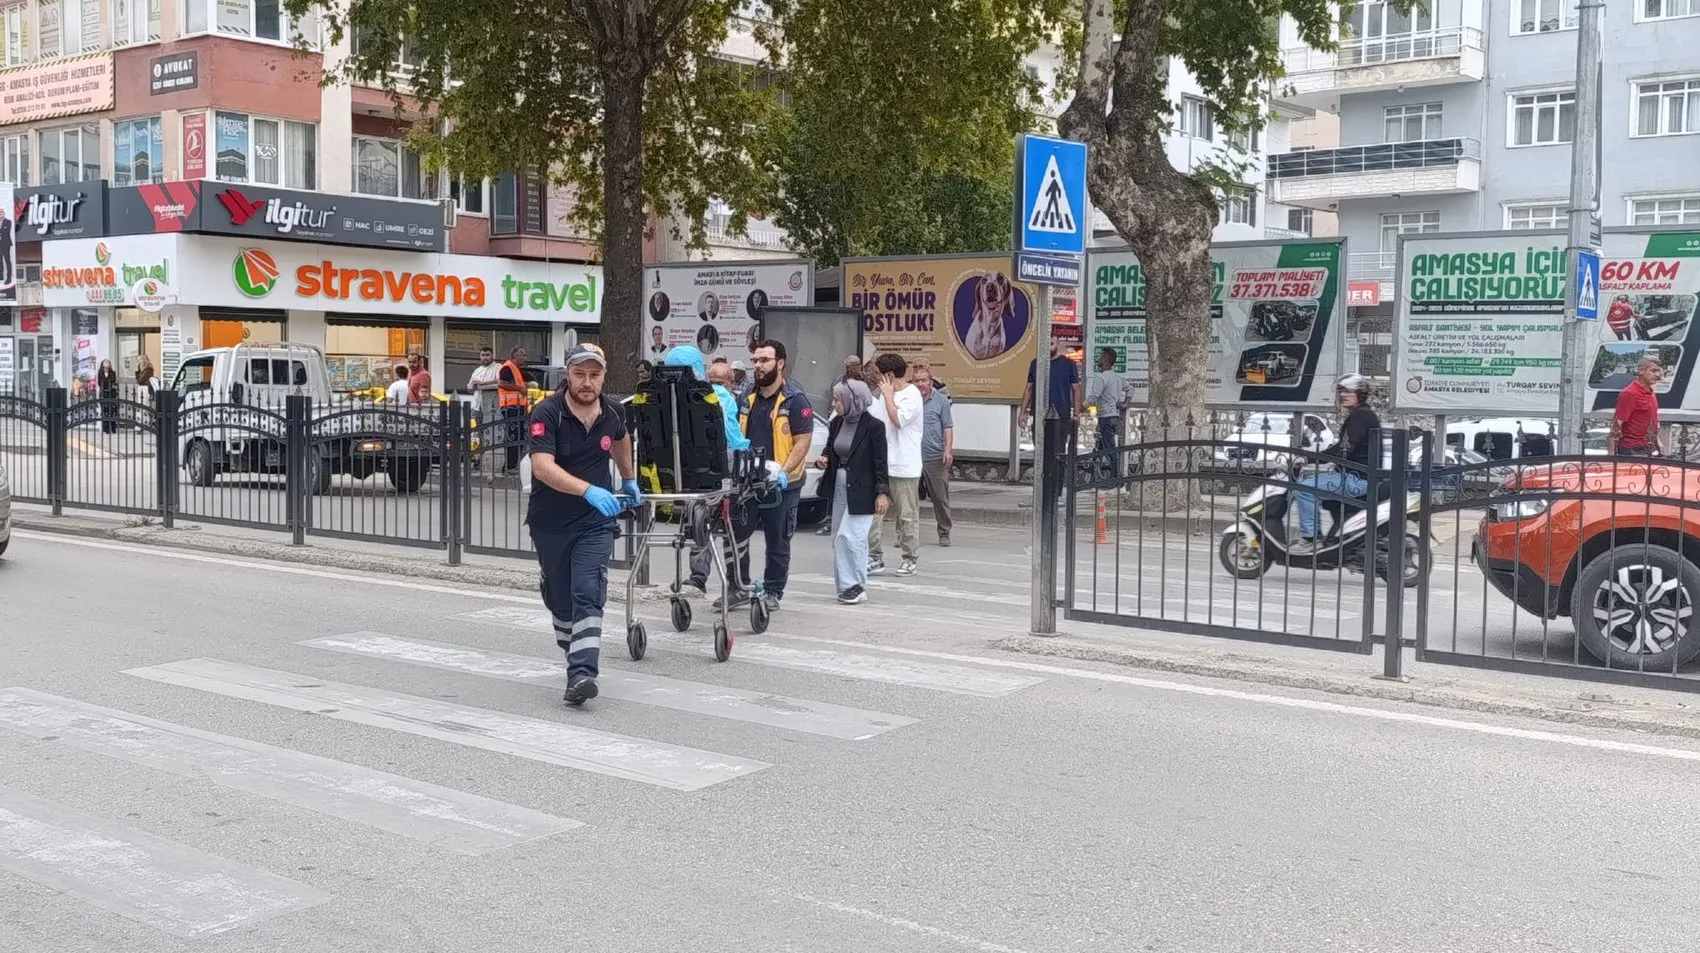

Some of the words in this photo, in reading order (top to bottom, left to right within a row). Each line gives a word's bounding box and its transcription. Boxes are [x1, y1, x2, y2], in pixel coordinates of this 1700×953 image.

[163, 58, 193, 74] AVUKAT
[9, 78, 31, 90] AMASYA
[28, 191, 81, 235] ilgitur
[265, 198, 337, 233] ilgitur
[355, 221, 371, 230] HAC
[385, 225, 405, 233] UMRE
[1021, 260, 1052, 279] ÖNCELİK
[1053, 267, 1078, 281] YAYANIN
[1411, 252, 1517, 277] AMASYA
[1600, 261, 1634, 281] 60
[1636, 260, 1681, 281] KM
[42, 265, 117, 289] stravena
[121, 257, 169, 286] travel
[852, 273, 867, 287] Bir
[898, 272, 915, 286] Bir
[1235, 271, 1276, 283] TOPLAM
[1278, 269, 1326, 282] MALİYETİ
[295, 260, 486, 308] stravena
[501, 273, 597, 314] travel
[1628, 282, 1672, 290] KAPLAMA
[852, 288, 880, 310] BİR
[885, 287, 936, 310] ÖMÜR
[864, 313, 934, 332] OSTLUK!
[1408, 324, 1434, 332] ASFALT
[1479, 324, 1494, 332] YOL
[1094, 326, 1125, 334] AMASYA
[1094, 335, 1121, 344] HİZMET
[1437, 341, 1462, 350] kamyon
[1499, 342, 1506, 350] kg
[1441, 348, 1466, 356] kamyon
[1506, 348, 1515, 357] kg
[1507, 381, 1537, 389] TURGAY
